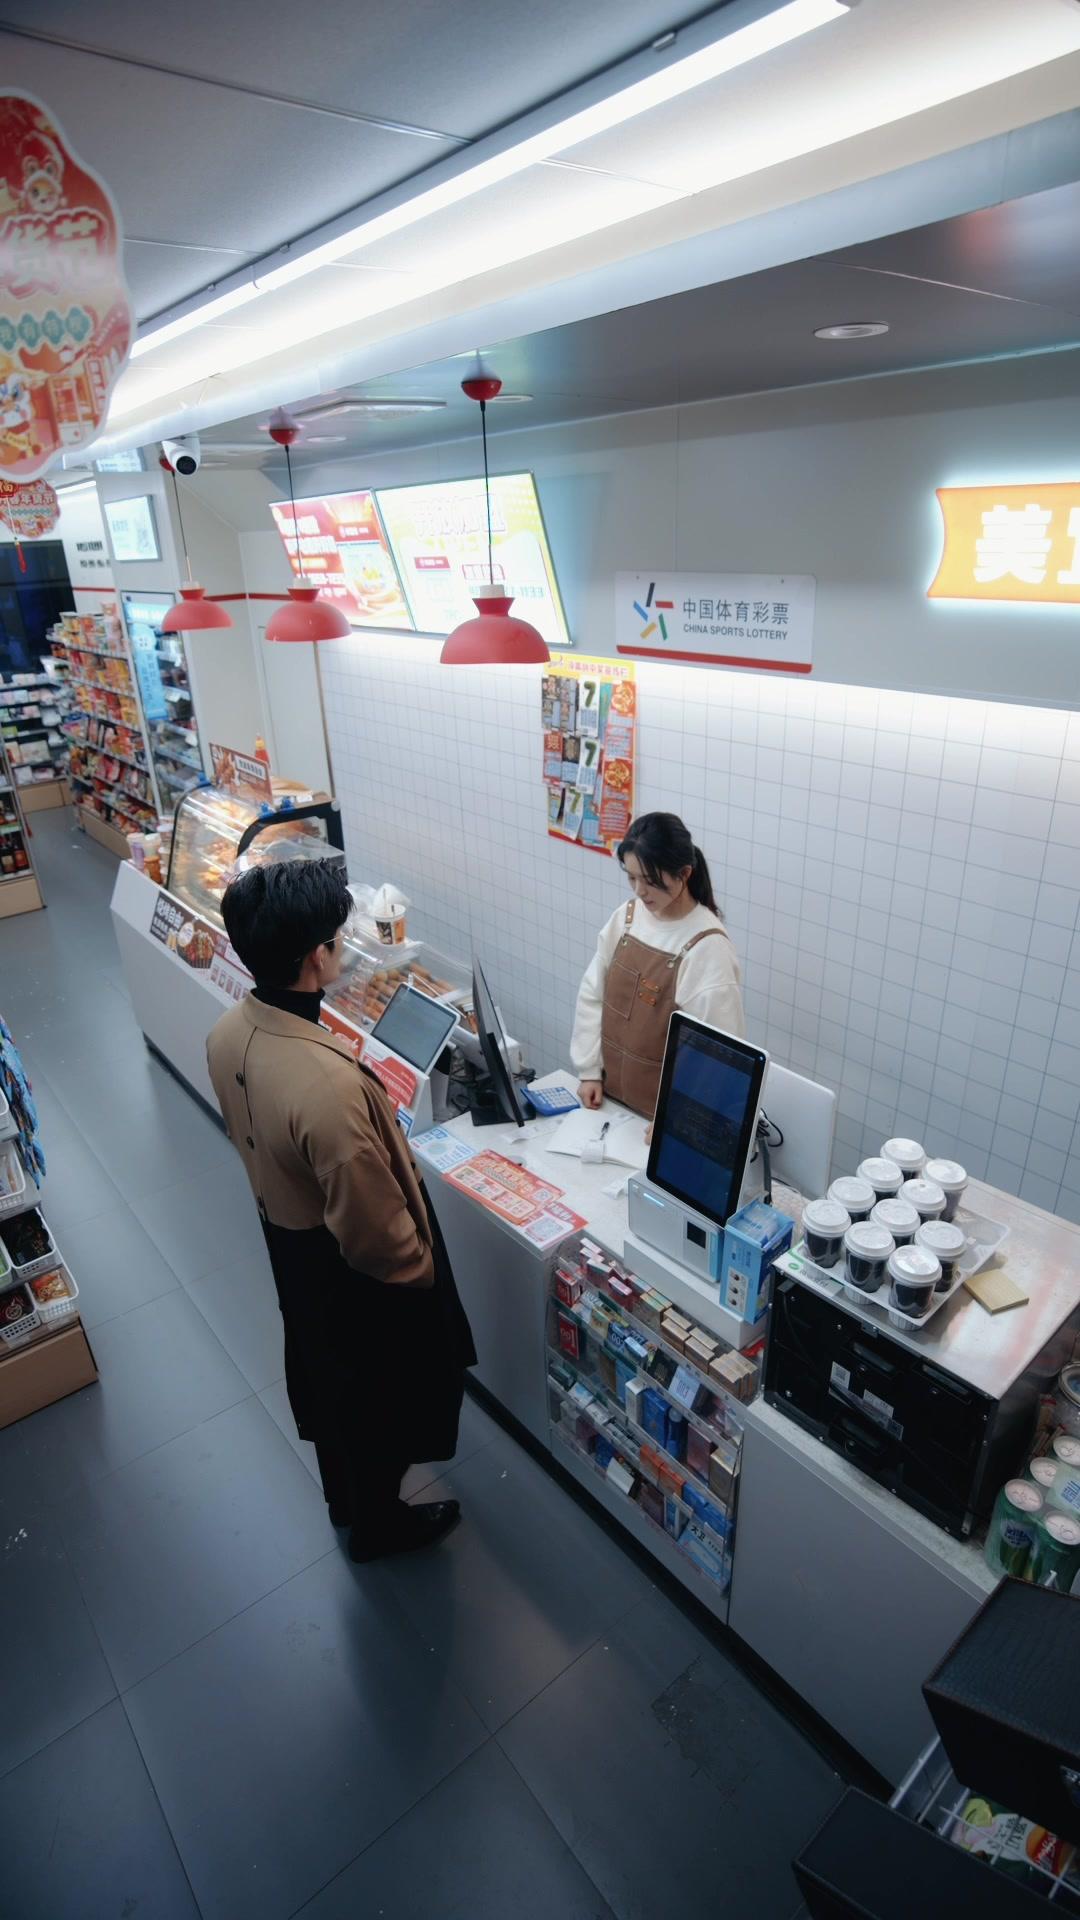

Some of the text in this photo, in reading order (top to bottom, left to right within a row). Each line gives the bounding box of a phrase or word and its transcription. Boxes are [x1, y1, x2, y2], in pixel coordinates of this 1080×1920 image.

[682, 597, 790, 625] 中国体育彩票
[683, 623, 788, 641] CHINA SPORTS LOTTERY
